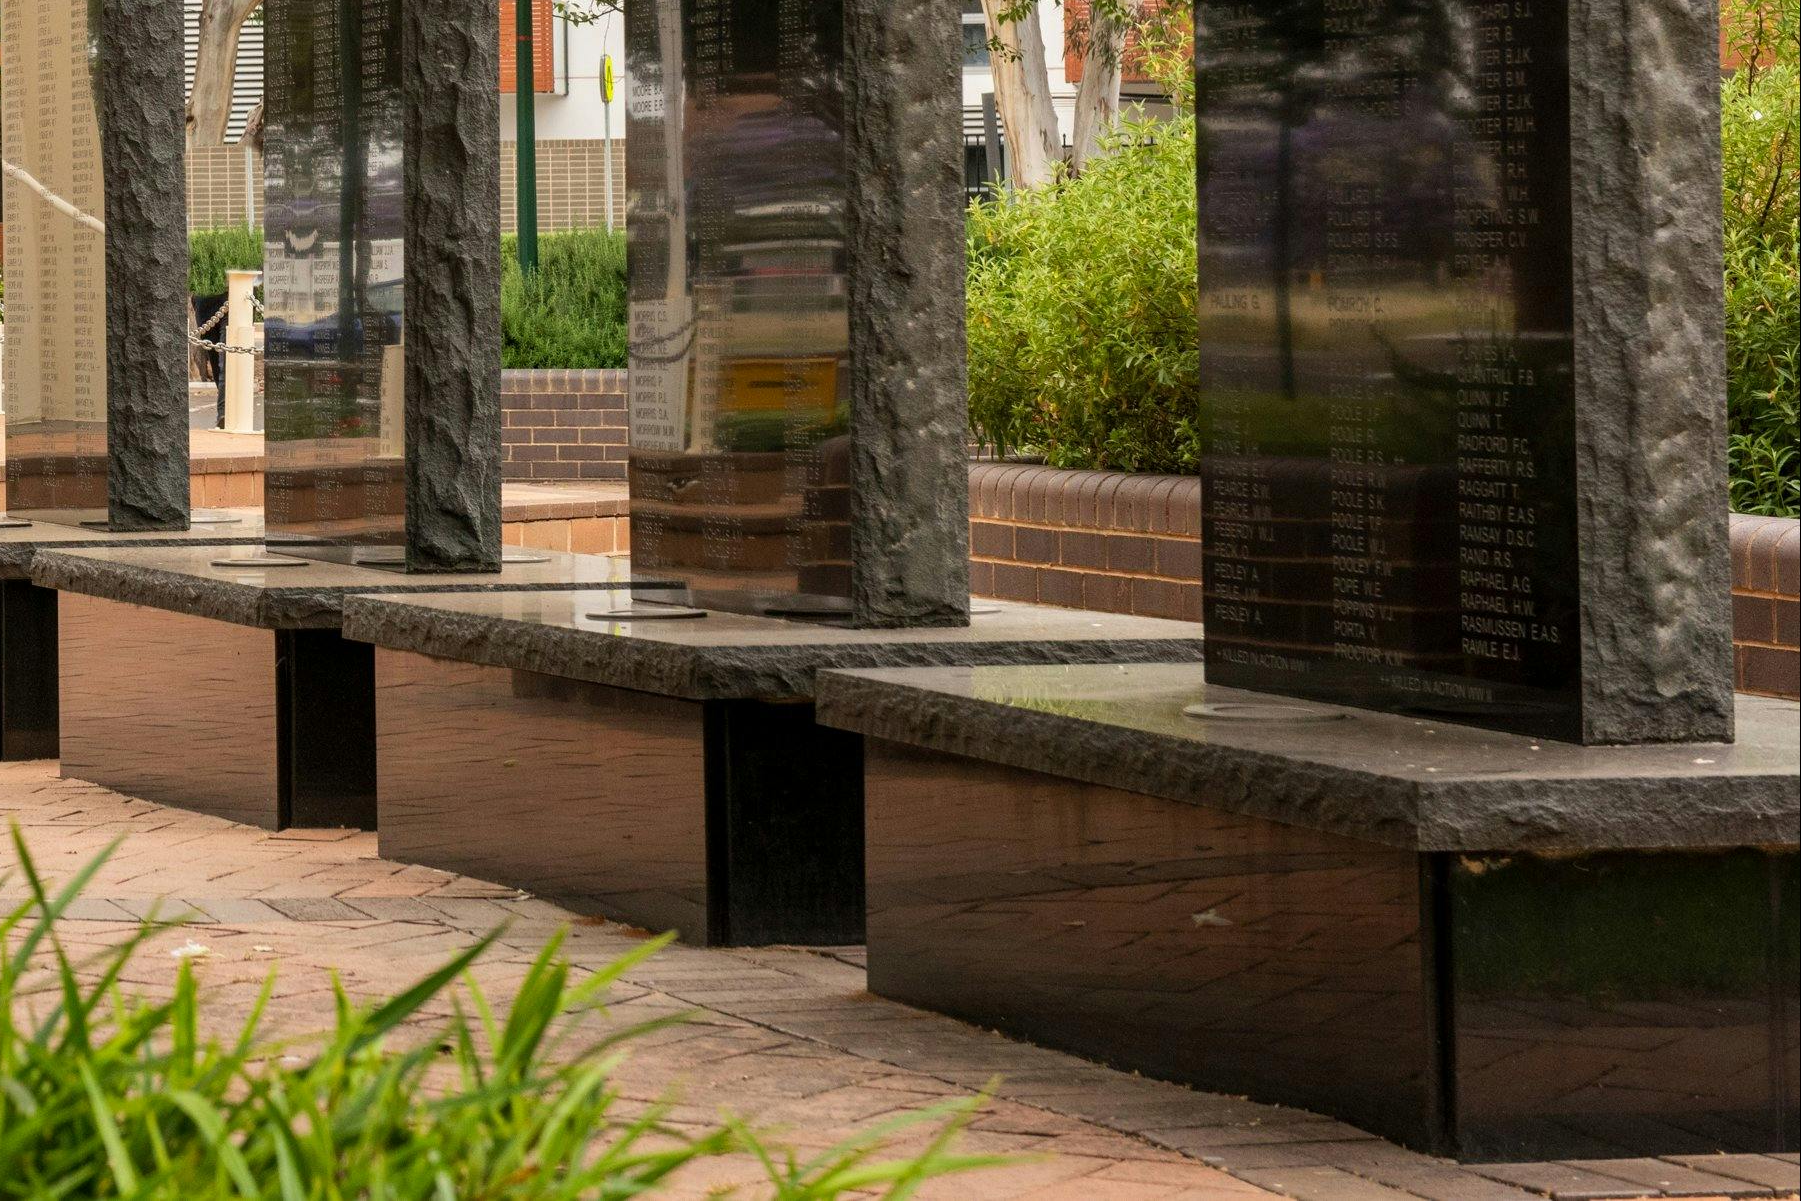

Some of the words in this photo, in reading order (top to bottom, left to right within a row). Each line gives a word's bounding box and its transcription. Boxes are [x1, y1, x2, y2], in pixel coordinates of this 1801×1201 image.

[1458, 434, 1508, 453] RADFORD
[1458, 457, 1511, 476] RAFFERTY
[1459, 479, 1507, 498] RAGGATT
[1459, 524, 1501, 543] RAMSAY
[1459, 547, 1489, 565] RAND
[1460, 570, 1508, 591] RAPHAEL
[1461, 592, 1508, 614] RAPHAEL
[1462, 615, 1526, 638] RASMUSSEN
[1462, 638, 1498, 658] RAWLE
